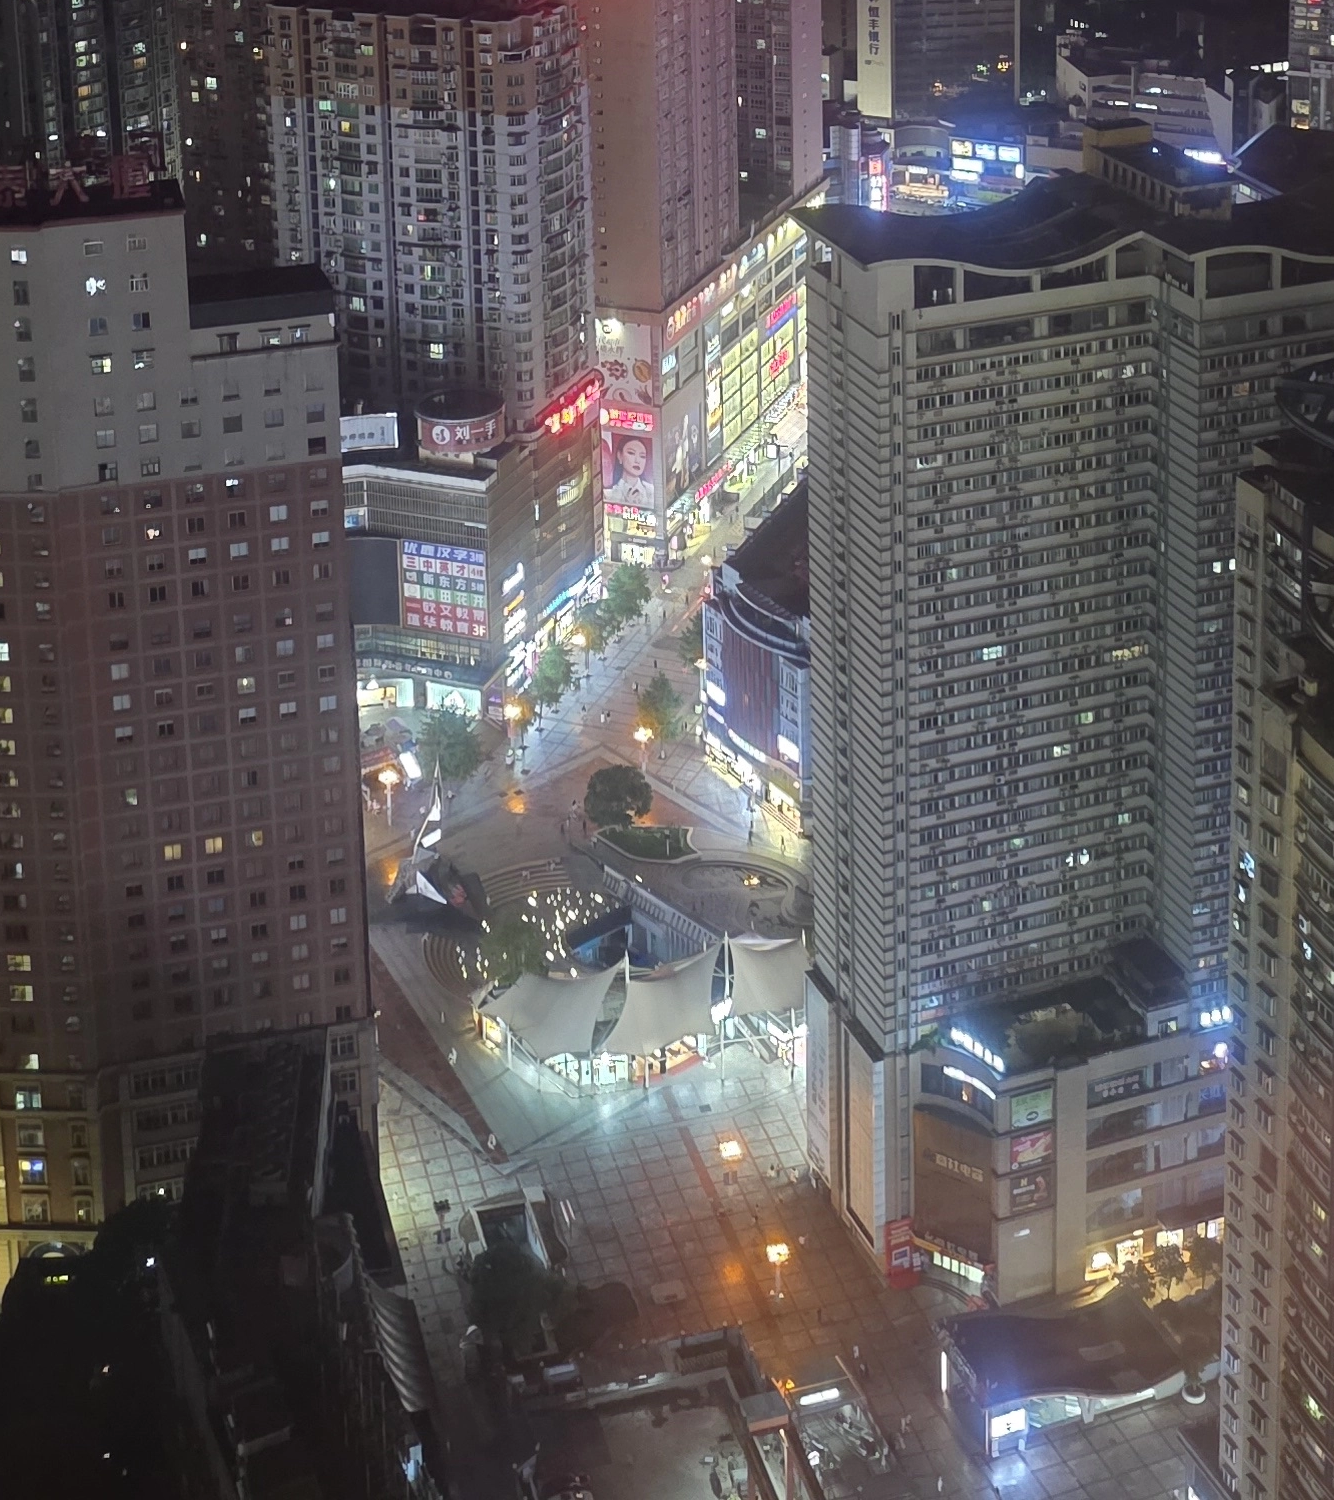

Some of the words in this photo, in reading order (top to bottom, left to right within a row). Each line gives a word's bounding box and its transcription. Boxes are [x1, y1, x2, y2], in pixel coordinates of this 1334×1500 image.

[867, 5, 880, 56] 恒丰银行
[454, 418, 496, 441] 刘一手
